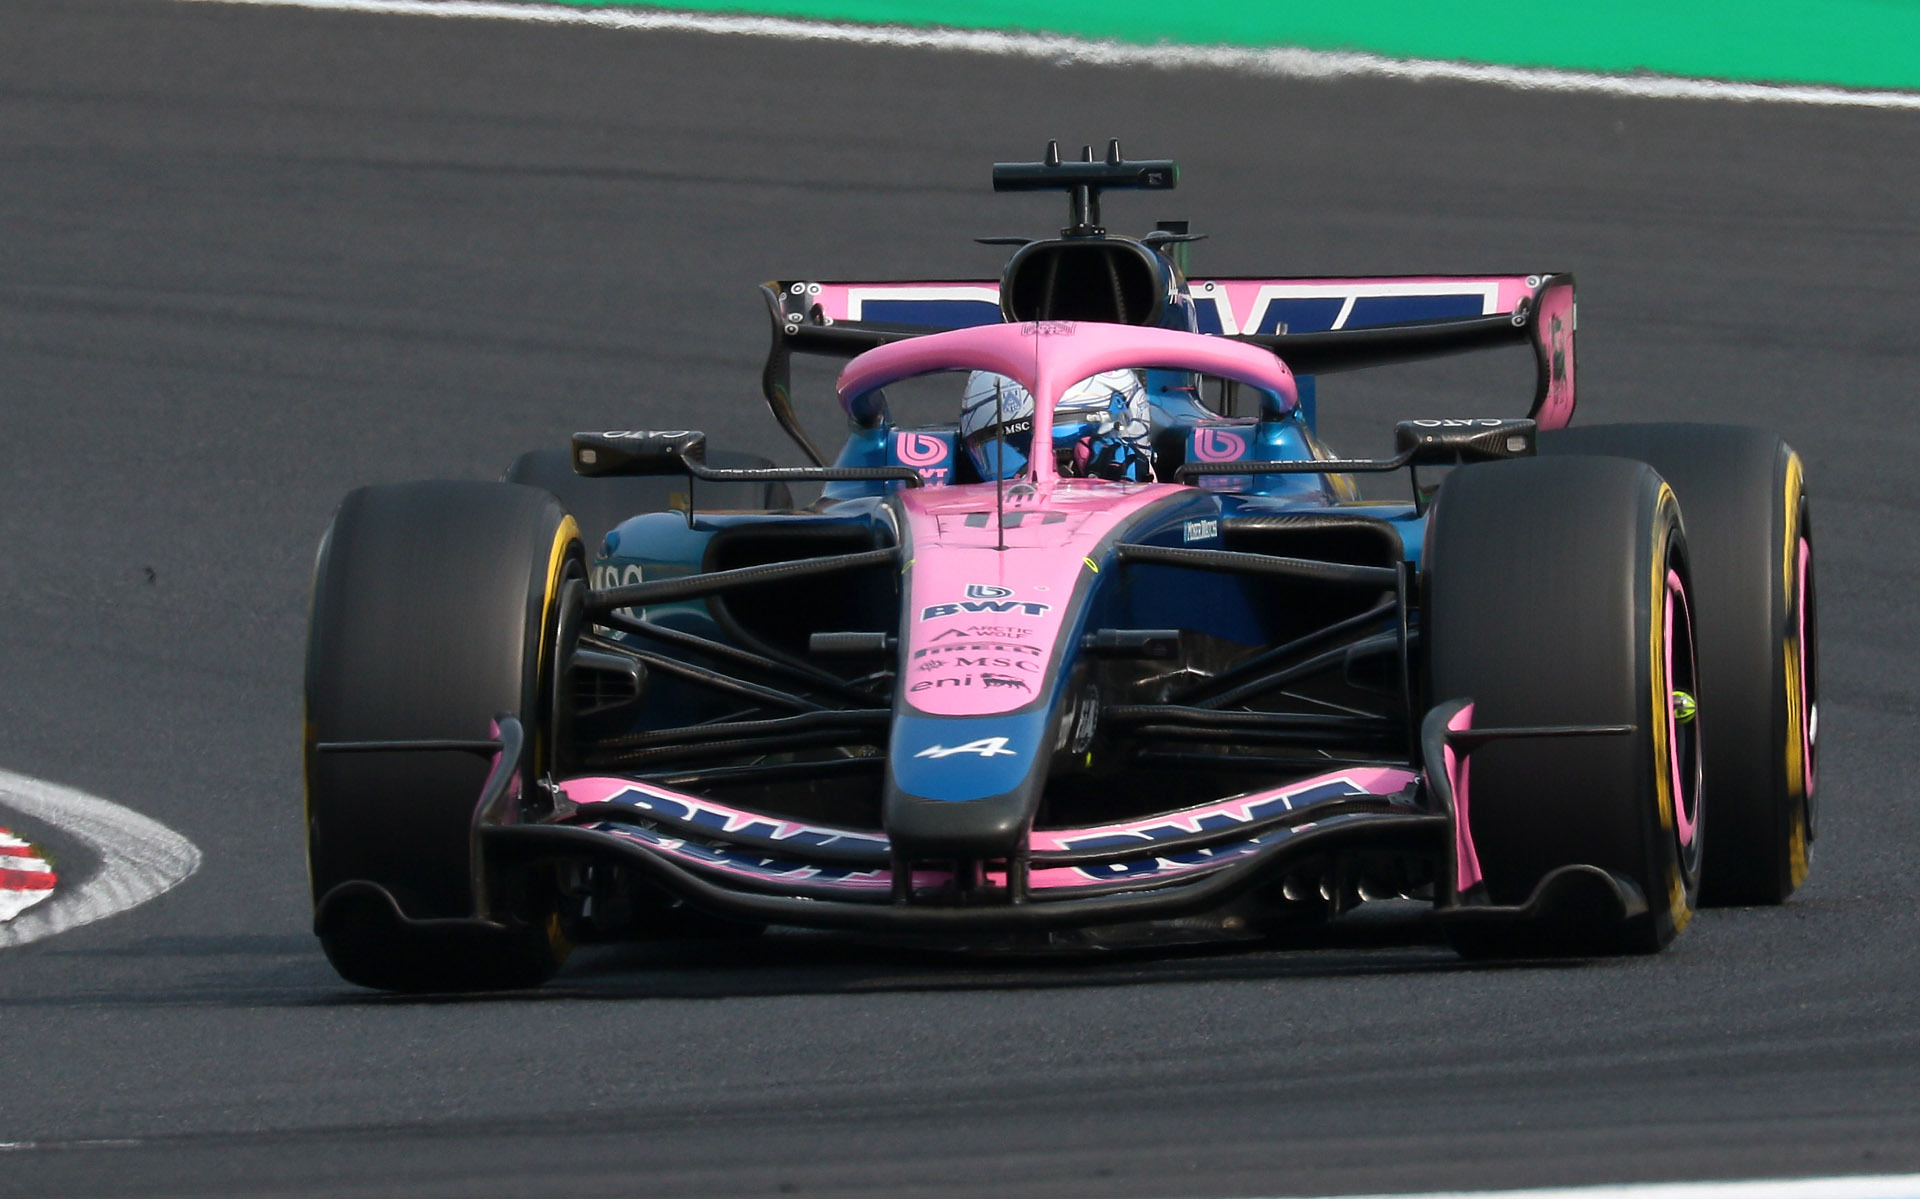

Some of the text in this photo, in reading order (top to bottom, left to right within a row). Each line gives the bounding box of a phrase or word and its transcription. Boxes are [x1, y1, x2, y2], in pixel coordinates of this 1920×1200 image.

[1004, 421, 1031, 436] MSC
[921, 601, 1051, 621] BWT
[967, 625, 1033, 635] ARCTIC
[976, 631, 1026, 639] WOLF
[954, 657, 1040, 673] MSC
[910, 674, 972, 692] eni
